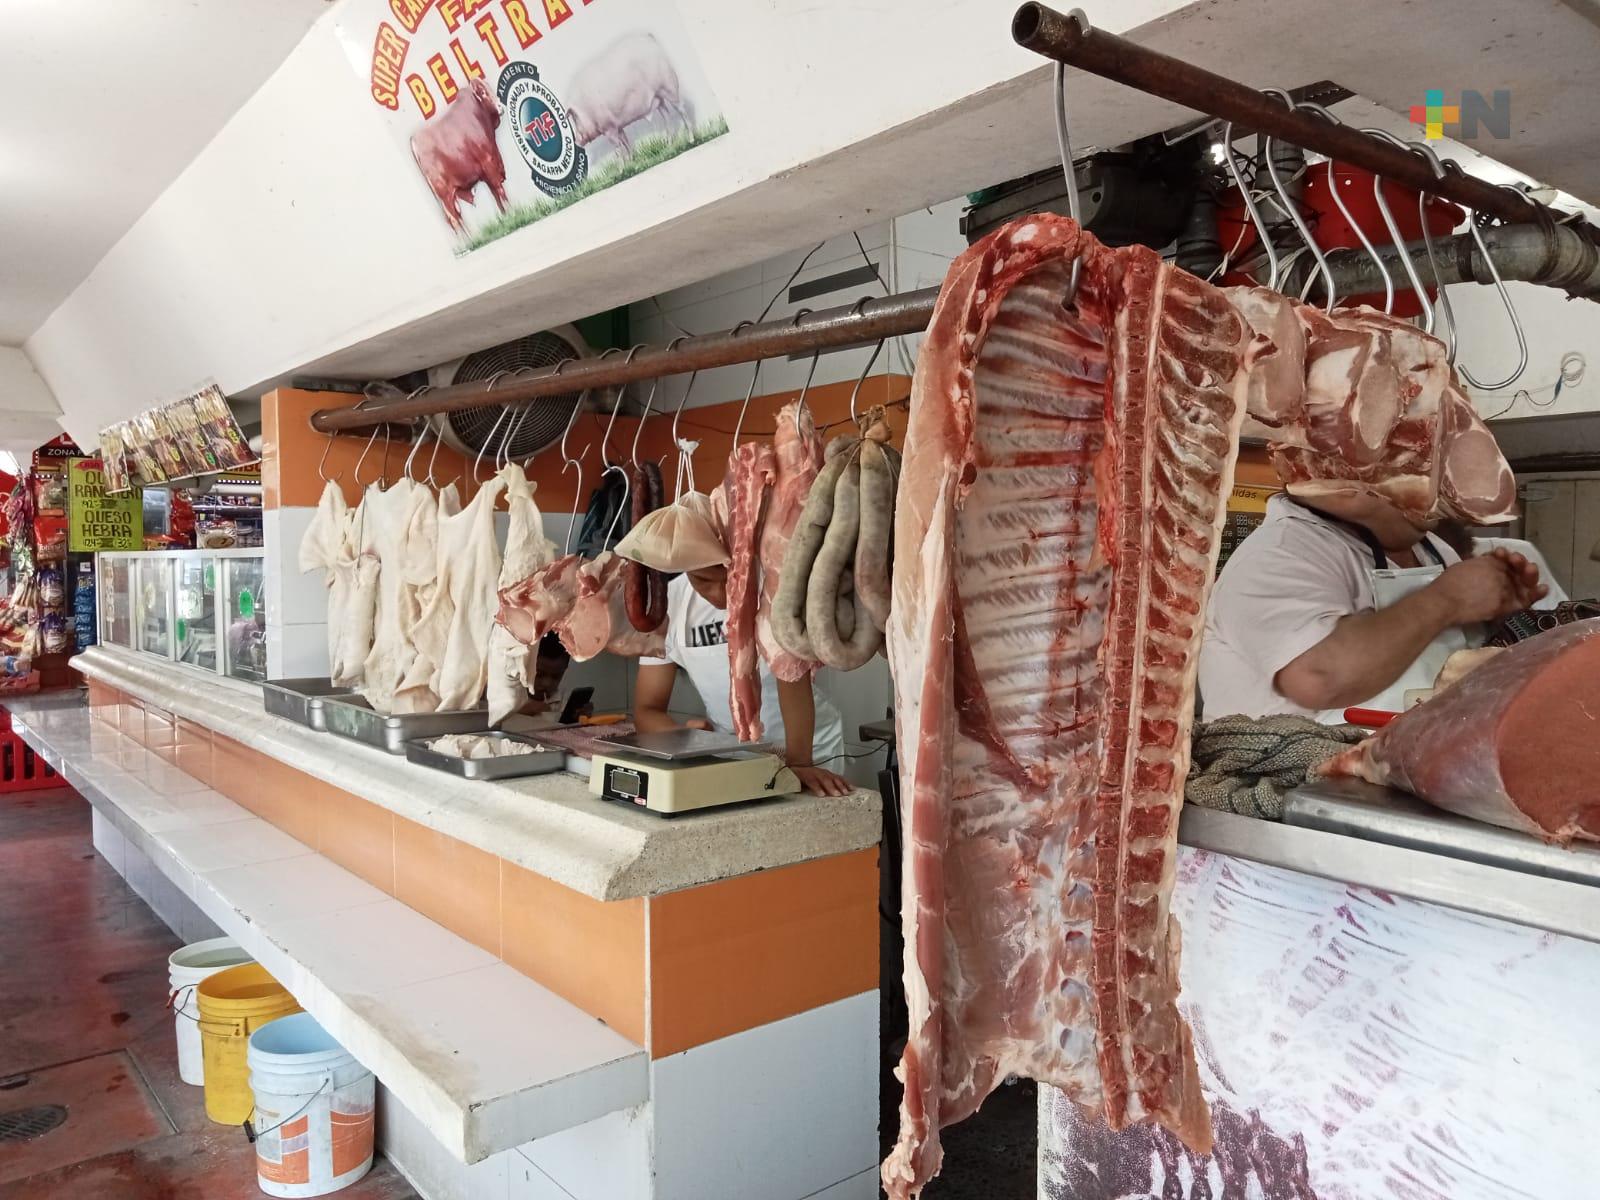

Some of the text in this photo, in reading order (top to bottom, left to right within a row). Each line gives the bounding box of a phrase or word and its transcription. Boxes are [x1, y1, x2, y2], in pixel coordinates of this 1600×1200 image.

[371, 21, 410, 111] SUPER
[405, 0, 593, 120] BELTRA
[498, 64, 535, 97] ALIMENTO
[531, 84, 568, 129] APROBADO
[524, 111, 556, 148] TIF
[47, 448, 76, 457] ZONA
[85, 471, 105, 486] QU
[82, 524, 133, 538] HEBRA
[84, 510, 132, 524] QUESO
